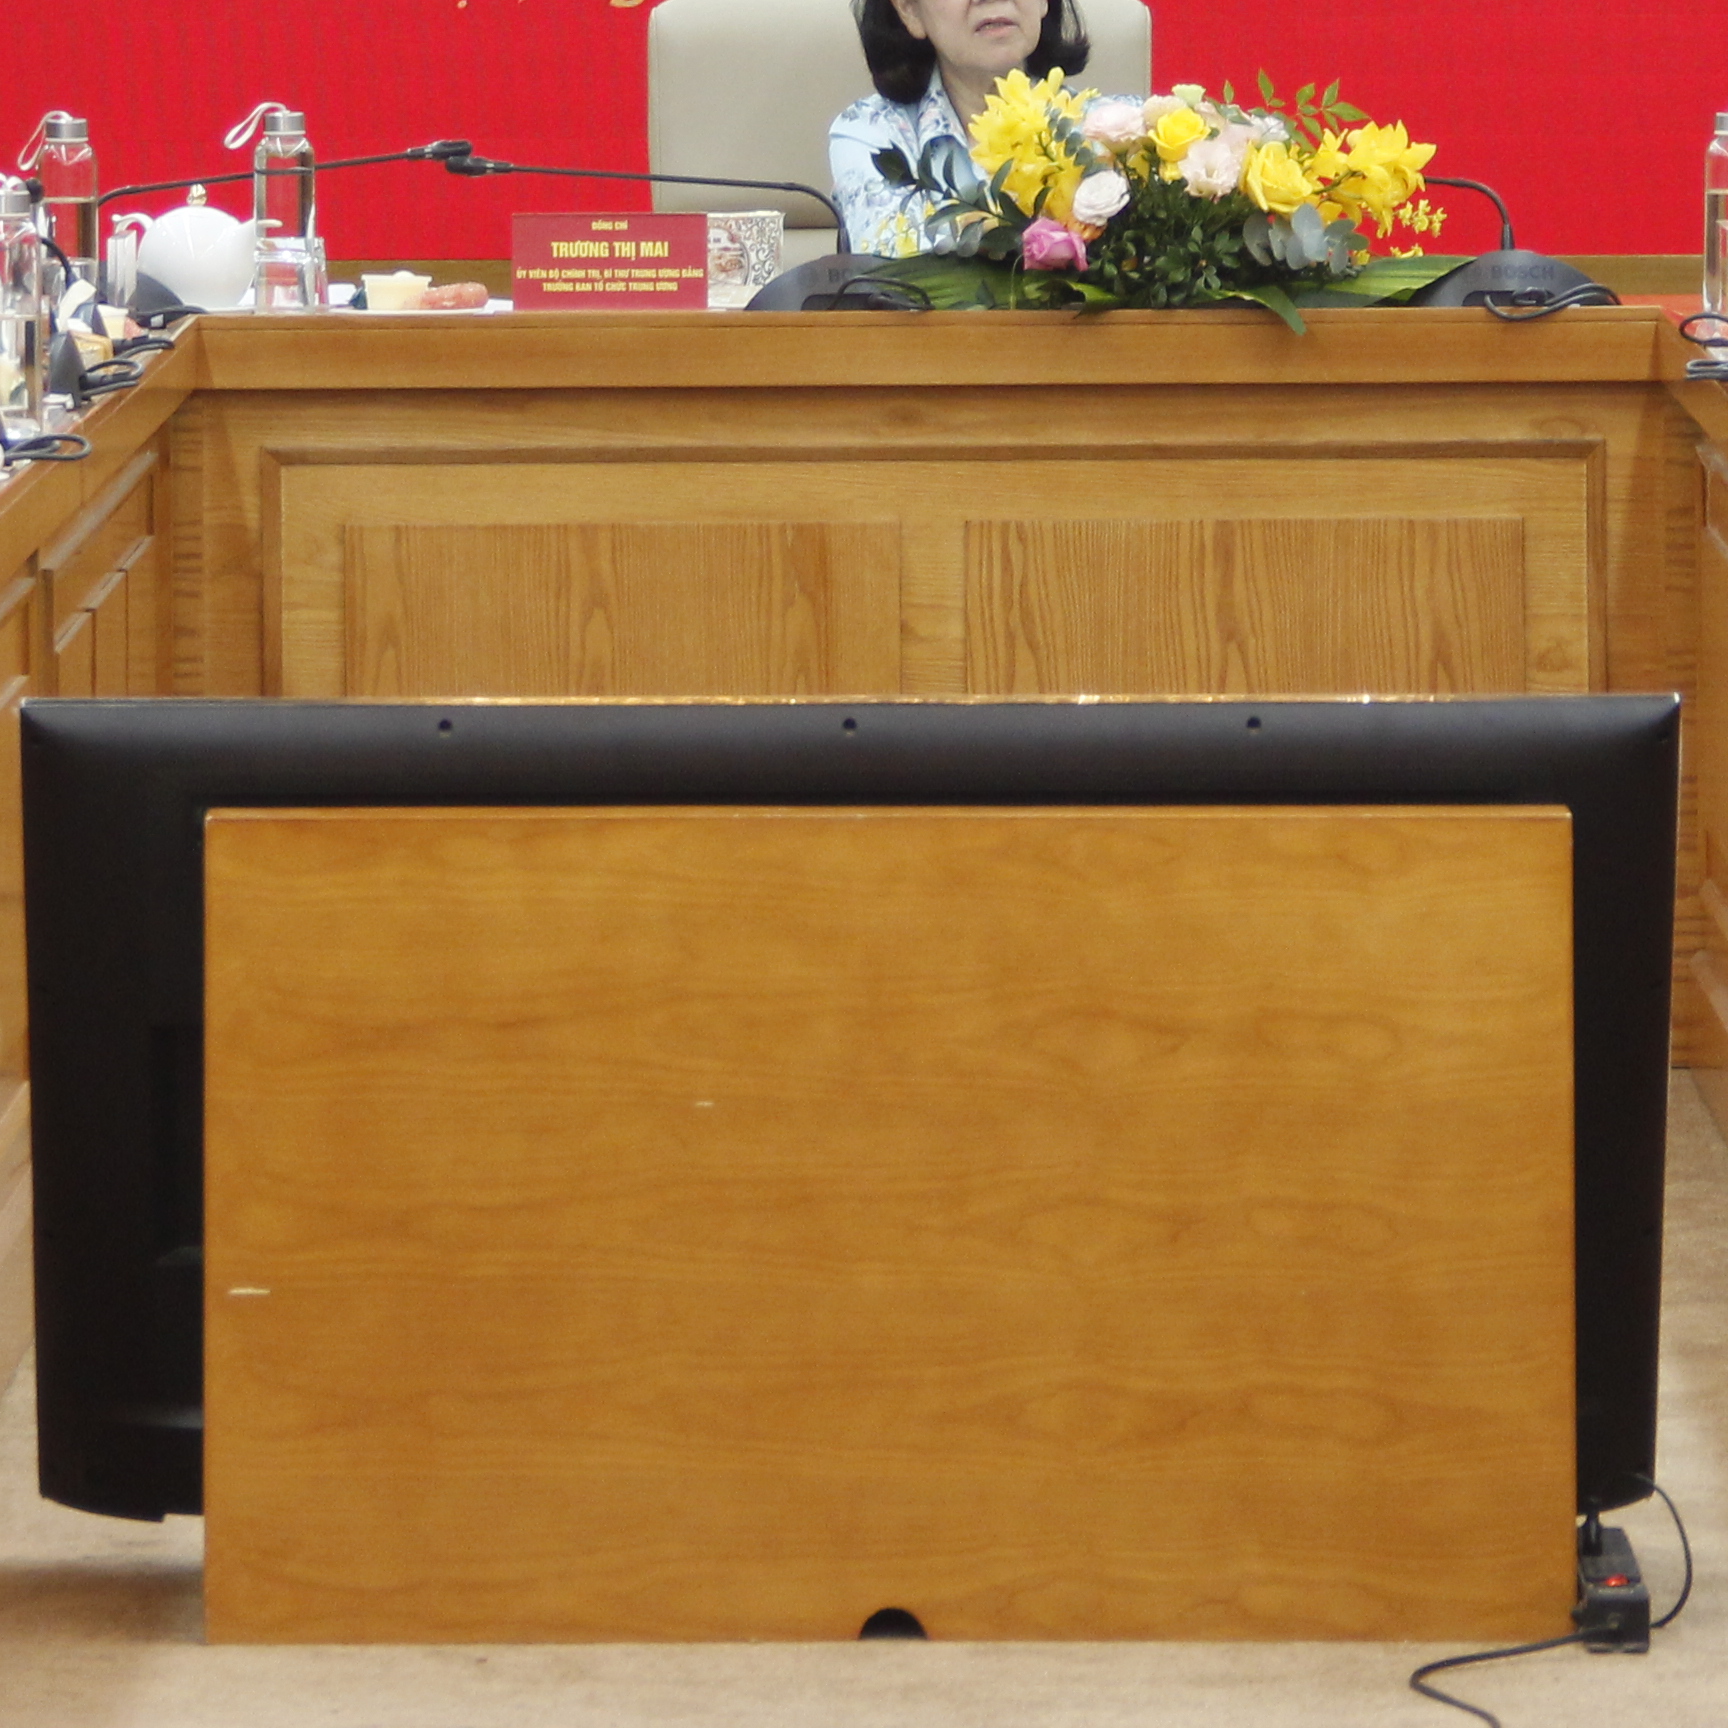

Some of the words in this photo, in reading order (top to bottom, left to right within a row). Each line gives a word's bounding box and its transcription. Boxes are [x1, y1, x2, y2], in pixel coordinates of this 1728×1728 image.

[550, 240, 610, 258] TRƯƠNG
[613, 240, 636, 261] THỊ
[639, 240, 669, 258] MAI
